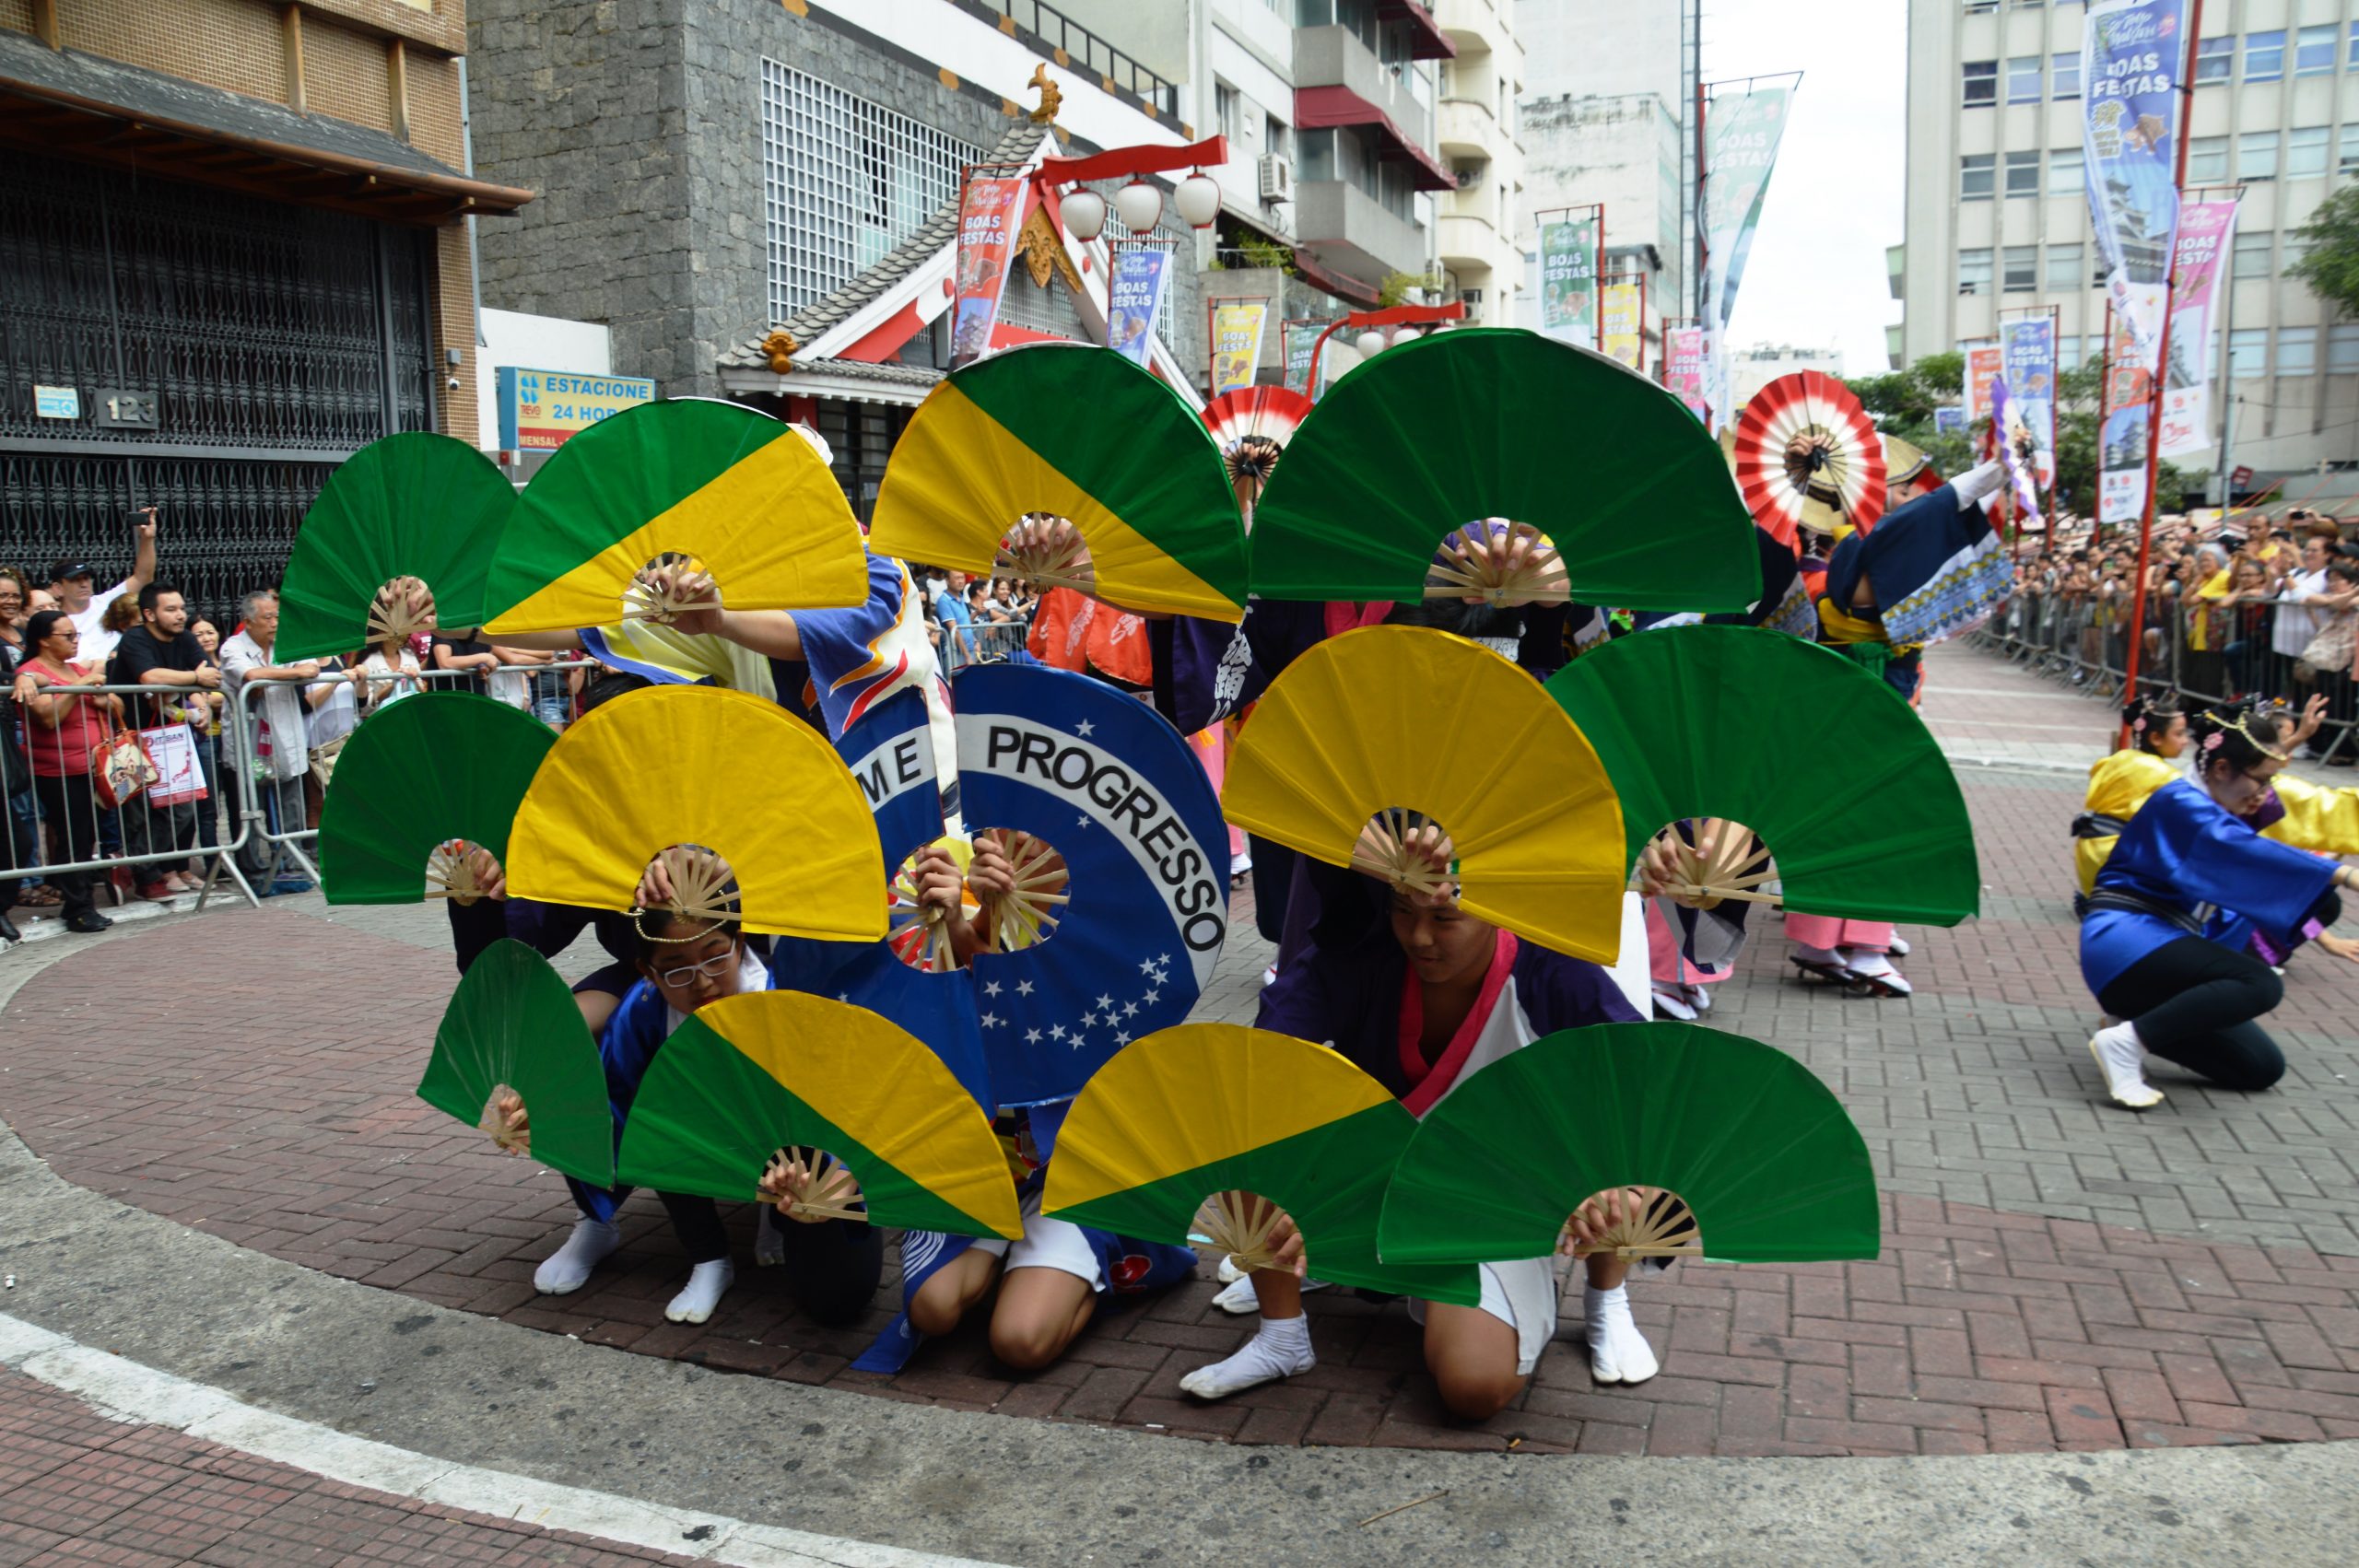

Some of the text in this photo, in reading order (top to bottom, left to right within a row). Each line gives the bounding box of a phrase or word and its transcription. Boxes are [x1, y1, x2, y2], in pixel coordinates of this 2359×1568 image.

[965, 215, 1001, 229] BOAS
[959, 231, 1005, 245] FESTAS
[1548, 252, 1582, 267] BOAS
[1116, 281, 1149, 294] BOAS
[546, 377, 649, 400] ESTACIONE
[107, 396, 155, 423] 123
[520, 404, 541, 415] TREVO
[553, 404, 573, 419] 24
[519, 435, 557, 448] MENSAL
[987, 725, 1226, 953] PROGRESSO
